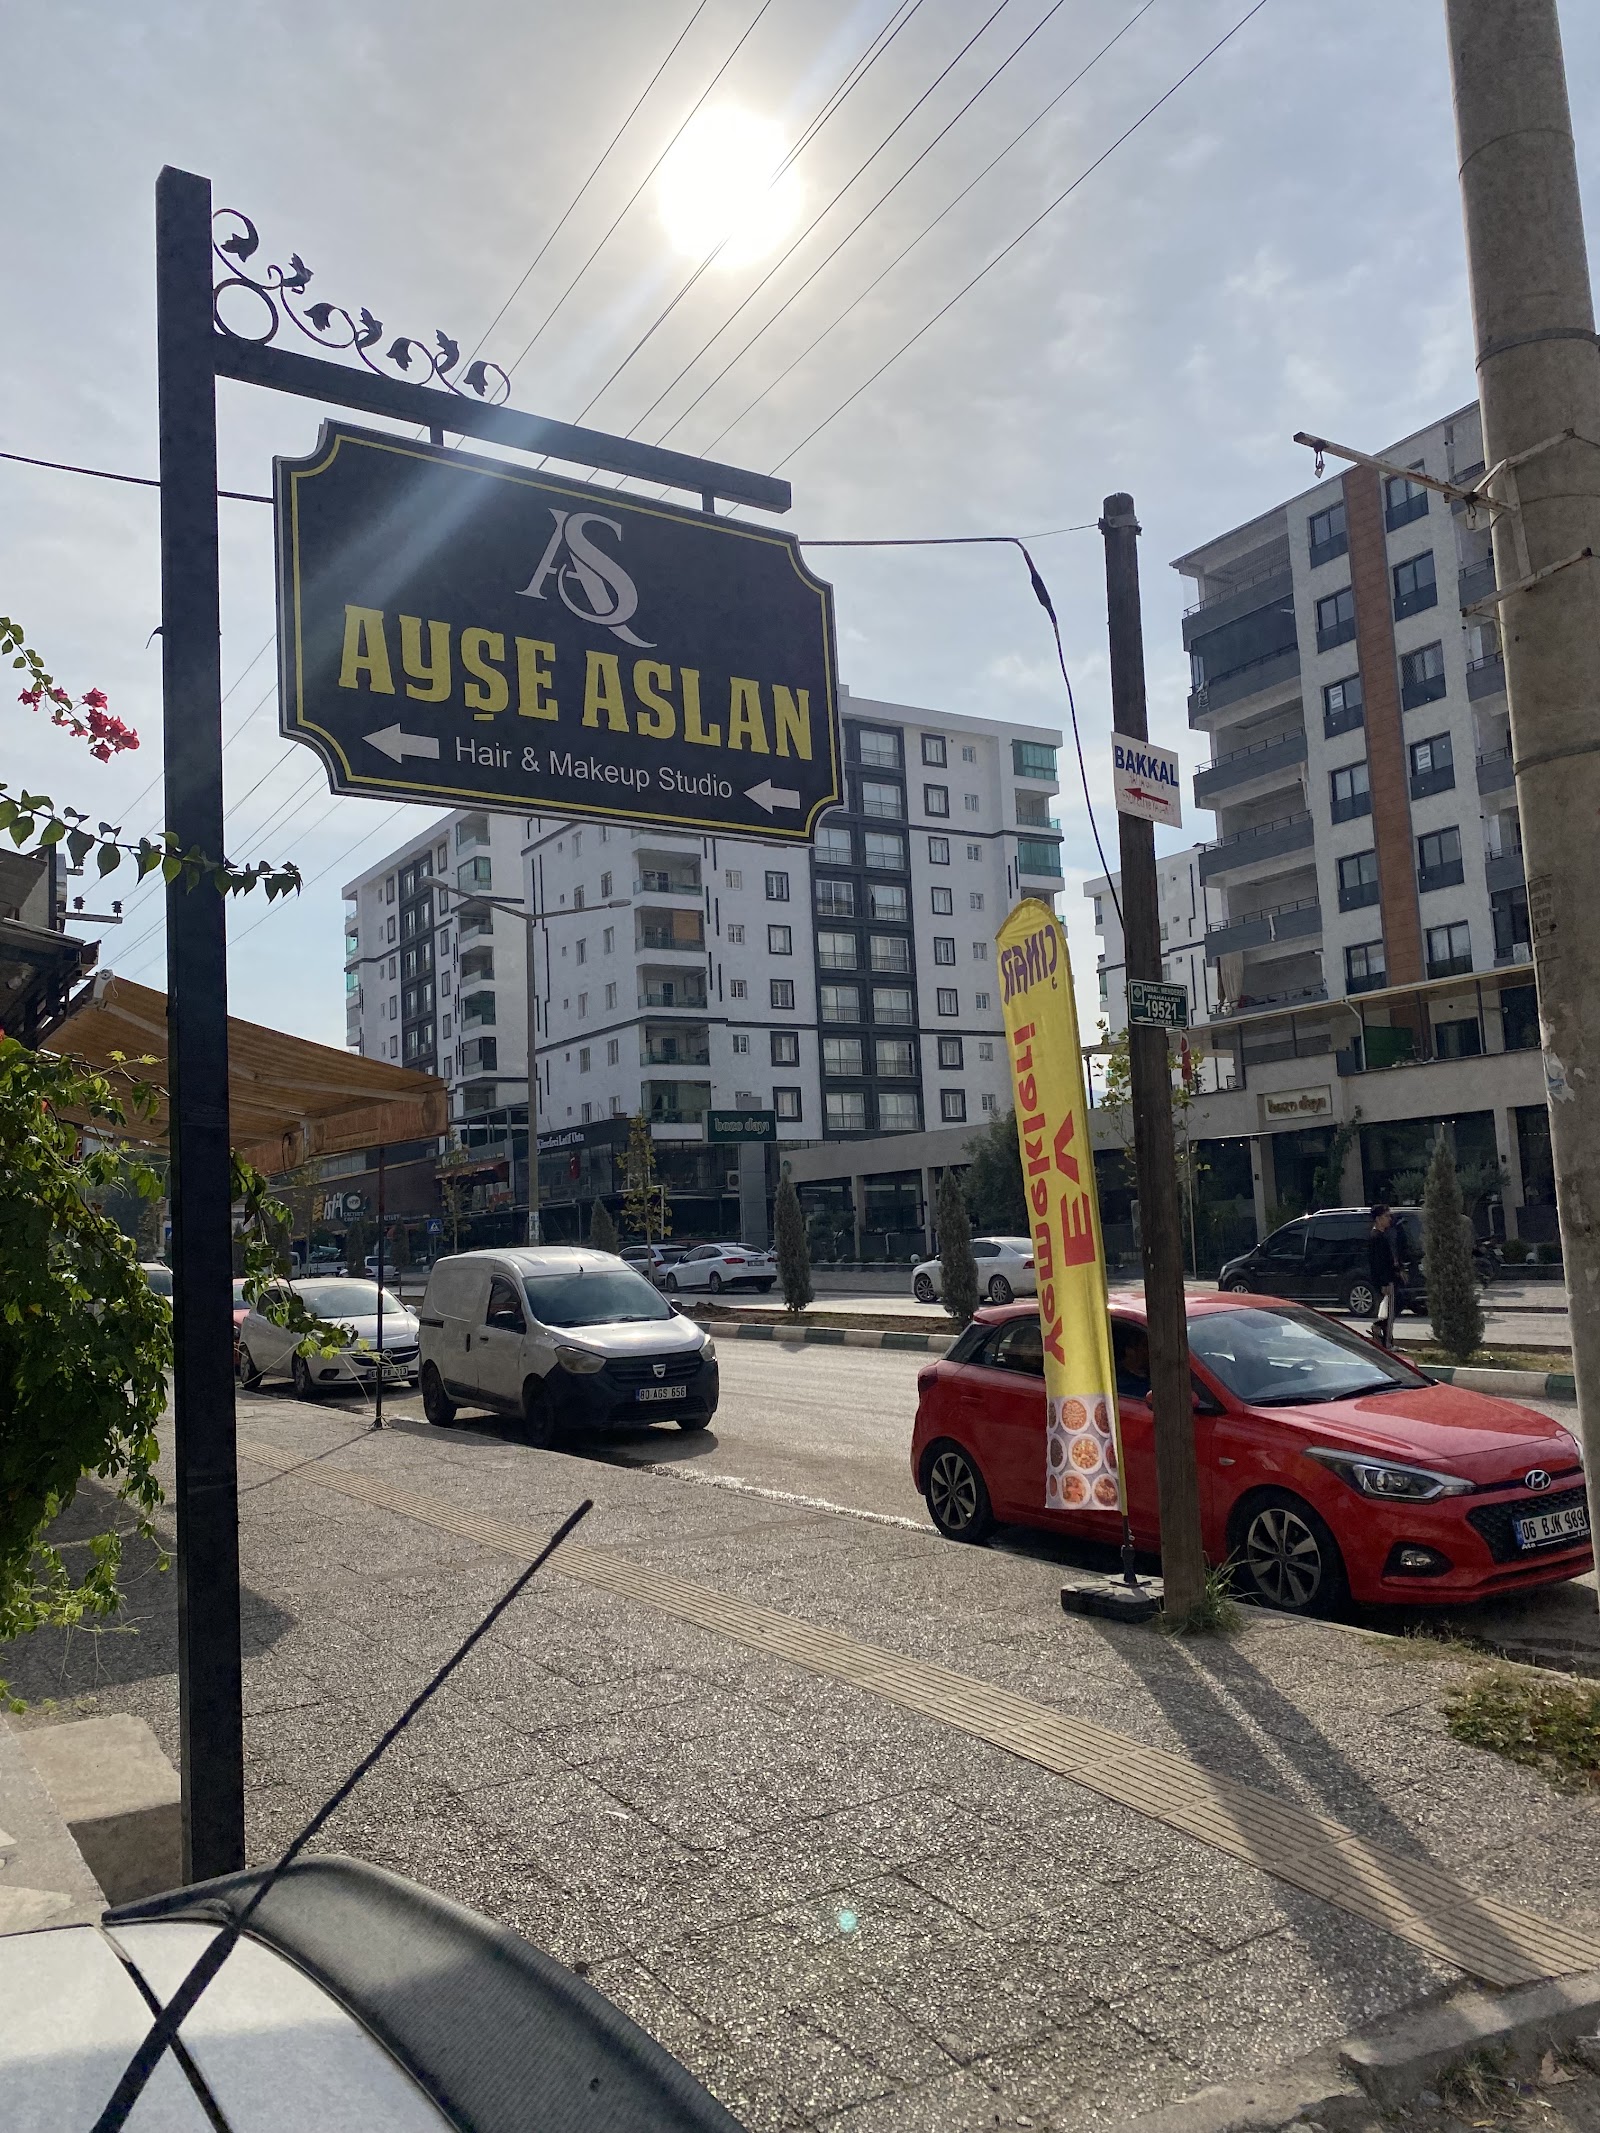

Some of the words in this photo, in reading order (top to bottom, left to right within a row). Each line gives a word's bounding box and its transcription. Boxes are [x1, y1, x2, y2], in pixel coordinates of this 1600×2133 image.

[338, 603, 559, 722] AYŞE
[582, 650, 813, 761] ASLAN
[455, 736, 511, 770] Hair
[521, 747, 541, 773] &
[549, 752, 650, 793] Makeup
[658, 767, 733, 798] Studio
[1114, 745, 1179, 787] BAKKAL
[1145, 1000, 1177, 1019] 19521
[1522, 1520, 1537, 1540] 06
[1565, 1510, 1585, 1530] 989
